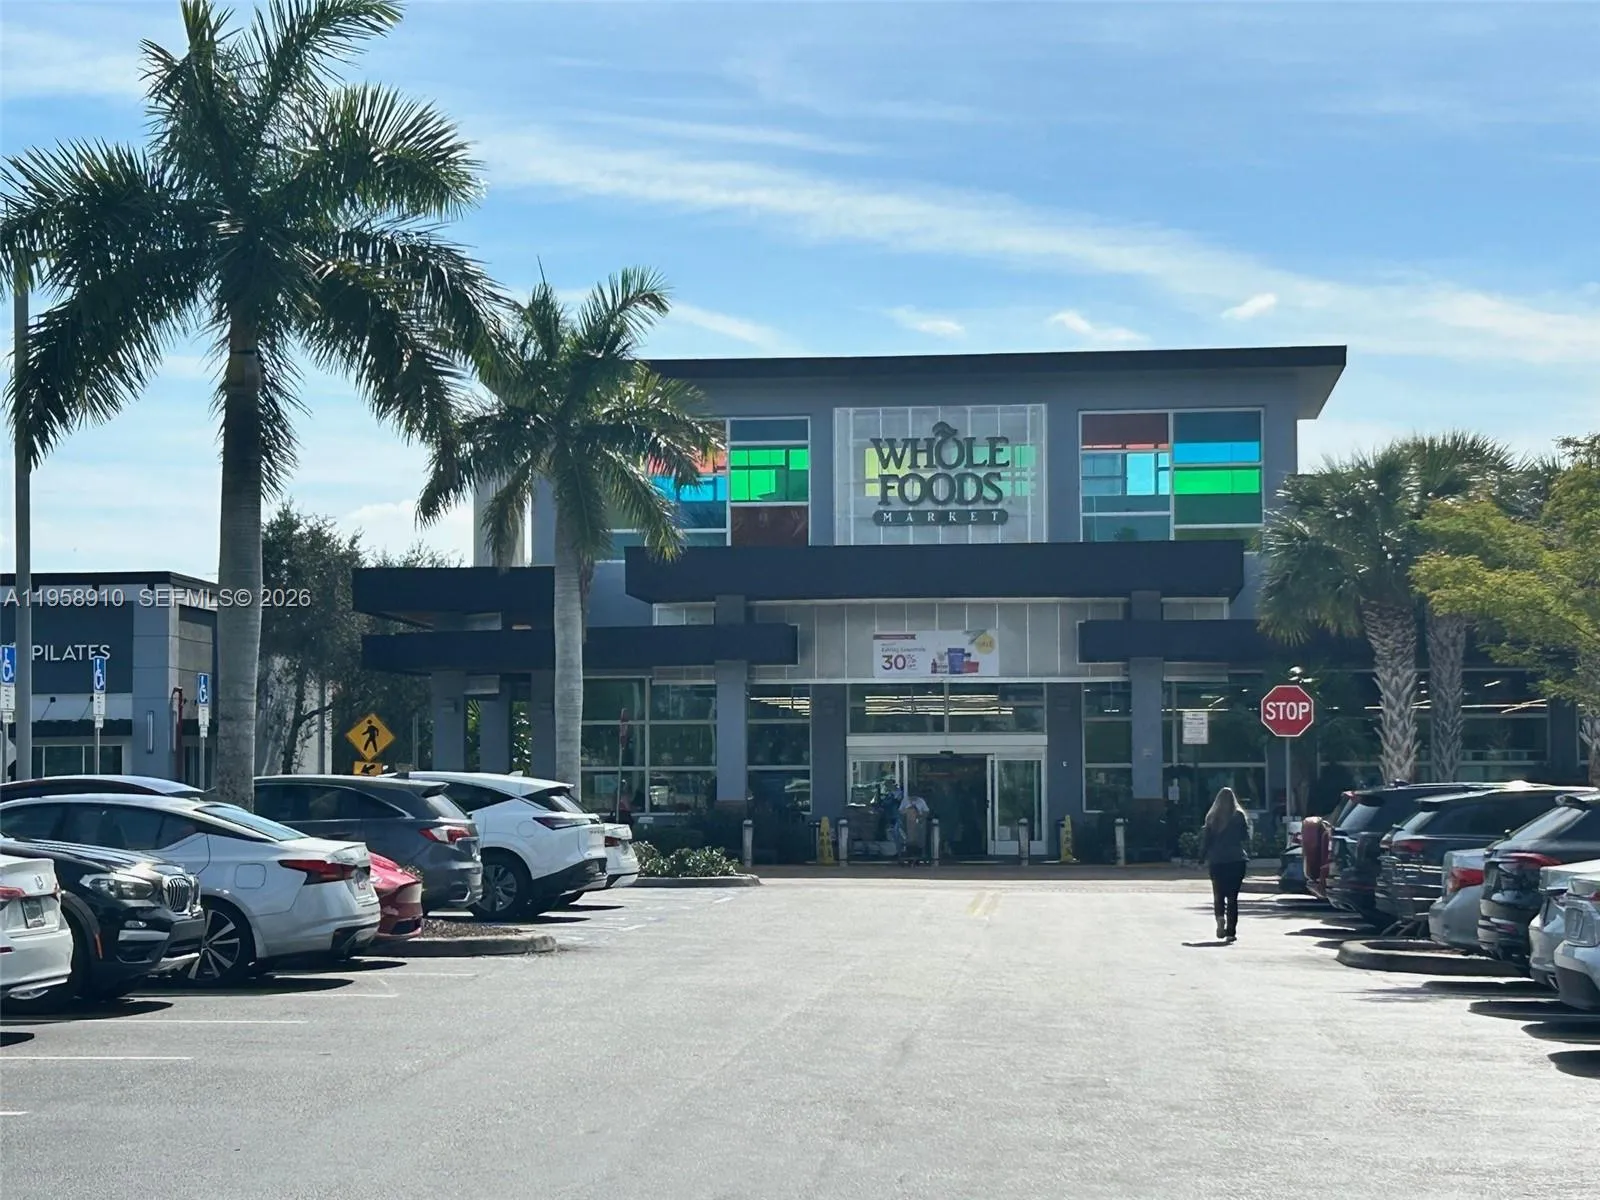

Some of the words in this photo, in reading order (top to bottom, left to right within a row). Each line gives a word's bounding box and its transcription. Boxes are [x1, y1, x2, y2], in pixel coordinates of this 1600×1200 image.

[870, 435, 1010, 470] WHOLE
[878, 472, 1003, 506] FOODS
[882, 511, 999, 522] MARKET
[31, 644, 111, 661] PILATES
[881, 654, 906, 670] 30
[1265, 701, 1310, 720] STOP
